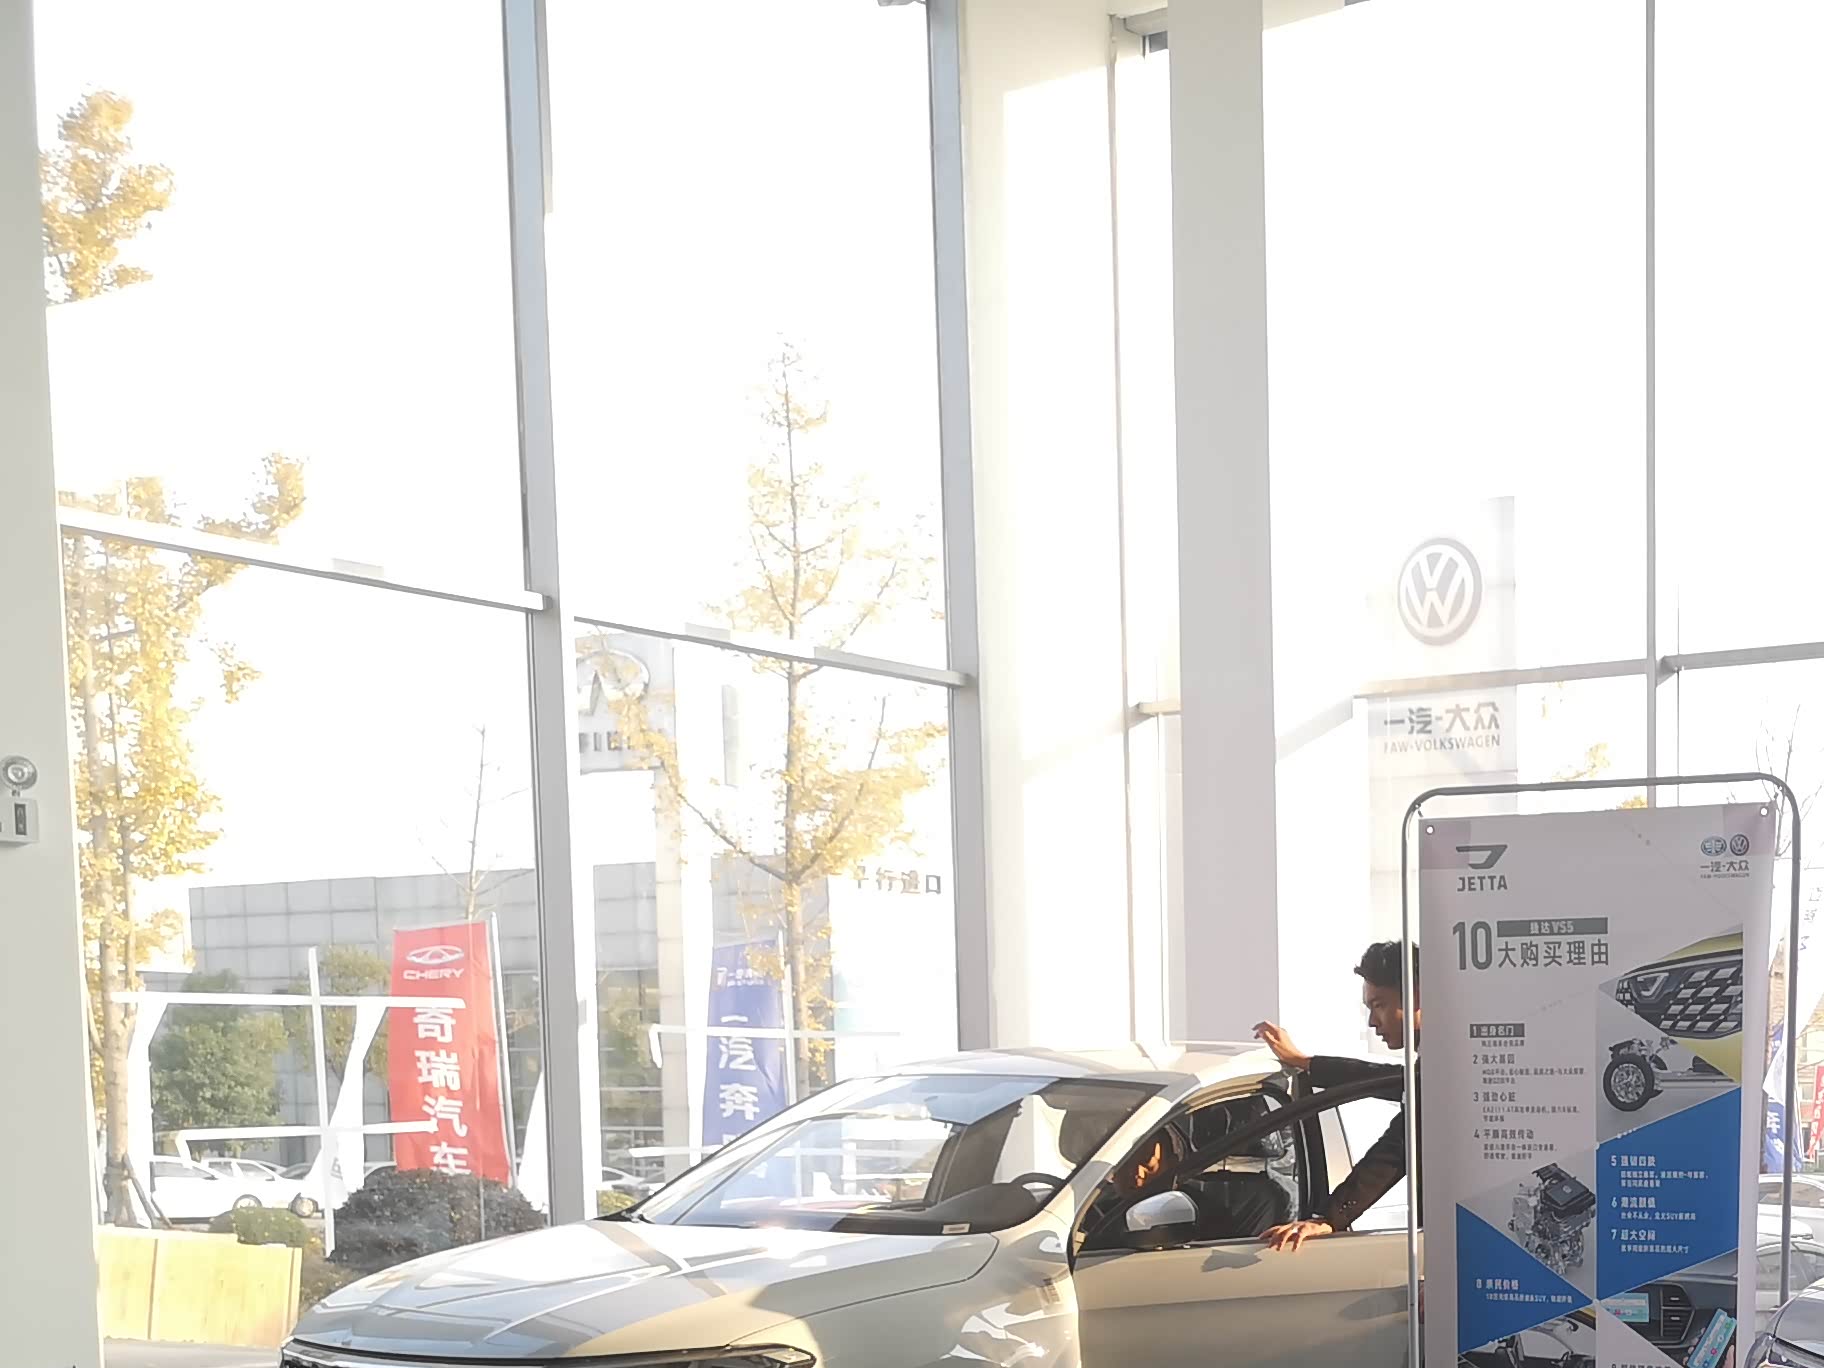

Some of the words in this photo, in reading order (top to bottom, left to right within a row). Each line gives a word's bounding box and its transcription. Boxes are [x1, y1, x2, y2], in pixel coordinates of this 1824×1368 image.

[1457, 875, 1508, 892] JETTA
[1452, 921, 1493, 970] 10
[1498, 938, 1609, 969] 大购买理由
[403, 968, 464, 980] CHERY
[718, 1015, 762, 1146] 一汽奔
